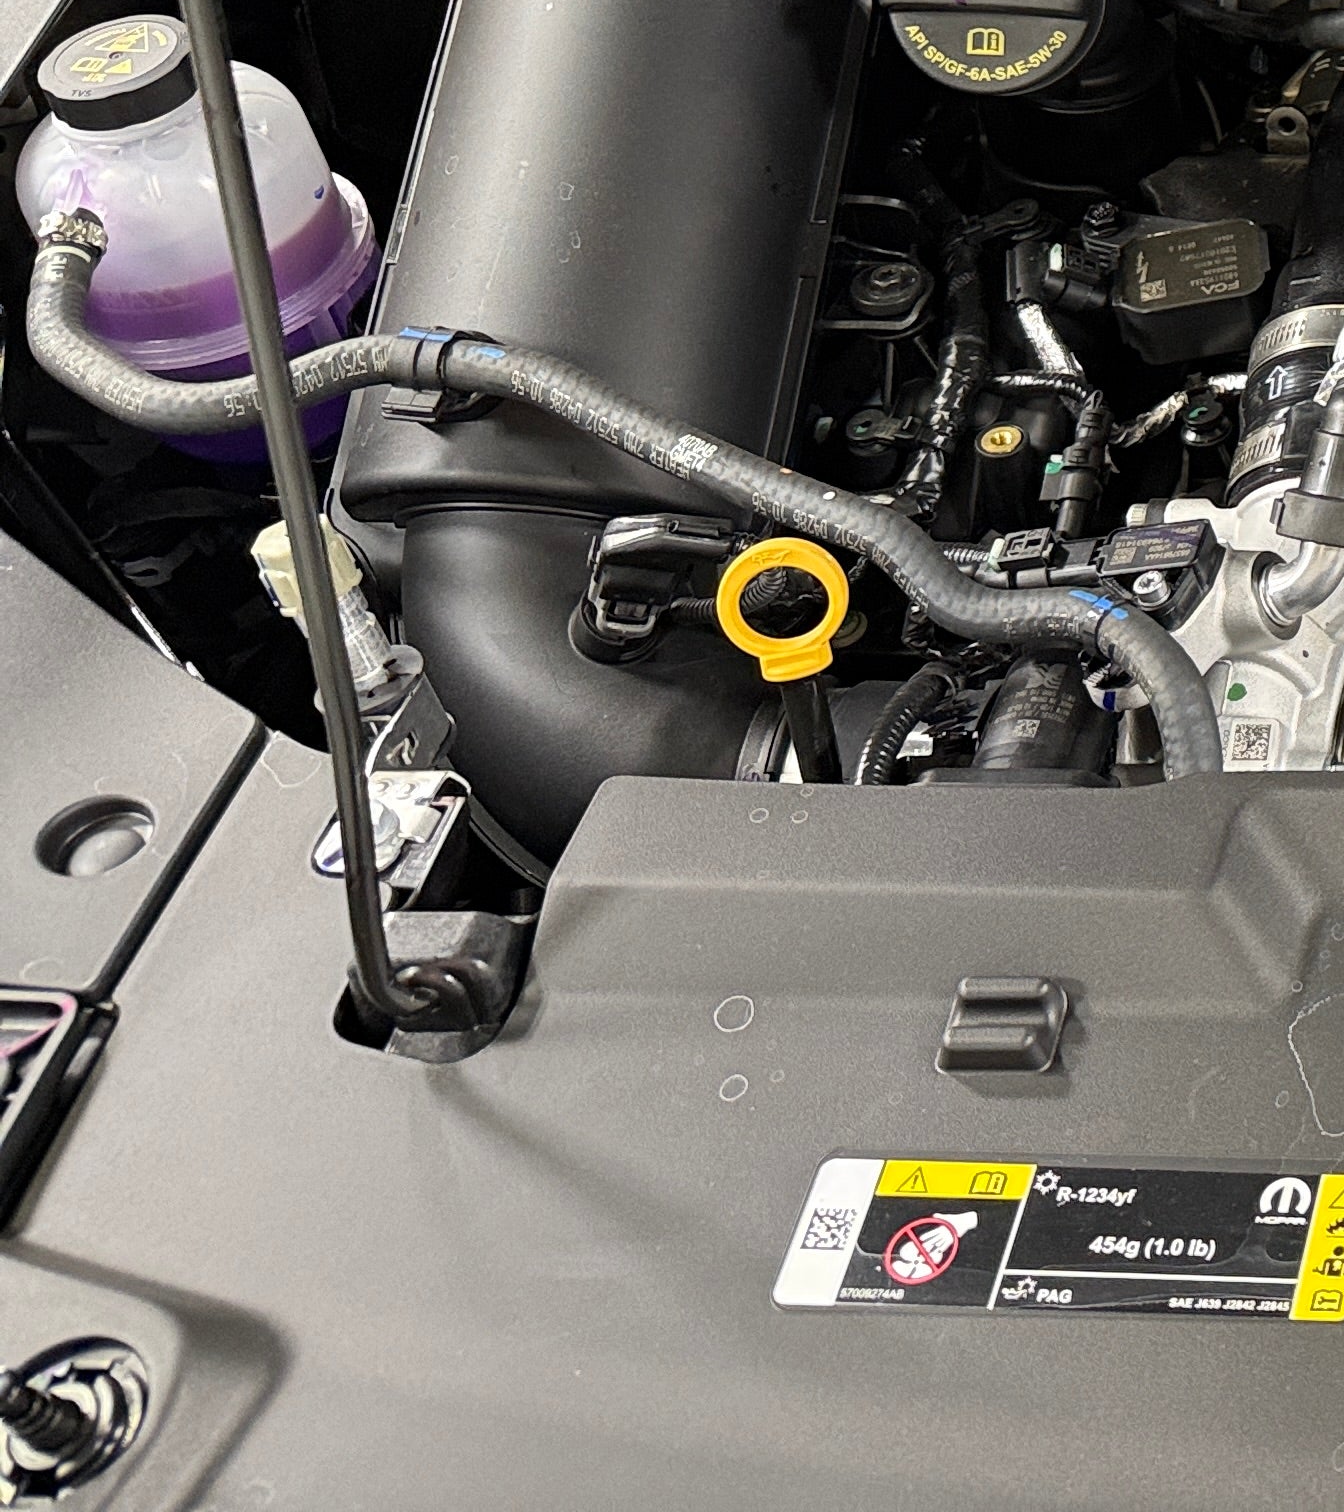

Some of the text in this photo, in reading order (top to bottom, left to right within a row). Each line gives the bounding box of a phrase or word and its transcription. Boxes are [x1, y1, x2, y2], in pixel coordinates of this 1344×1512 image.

[904, 24, 926, 50] API
[71, 89, 93, 98] TVS
[1200, 280, 1240, 295] FCA
[1057, 1185, 1137, 1207] R-1234yf
[1089, 1235, 1216, 1261] 454g (1.0 lb)
[1036, 1289, 1073, 1304] PAG
[1169, 1297, 1194, 1309] SAE
